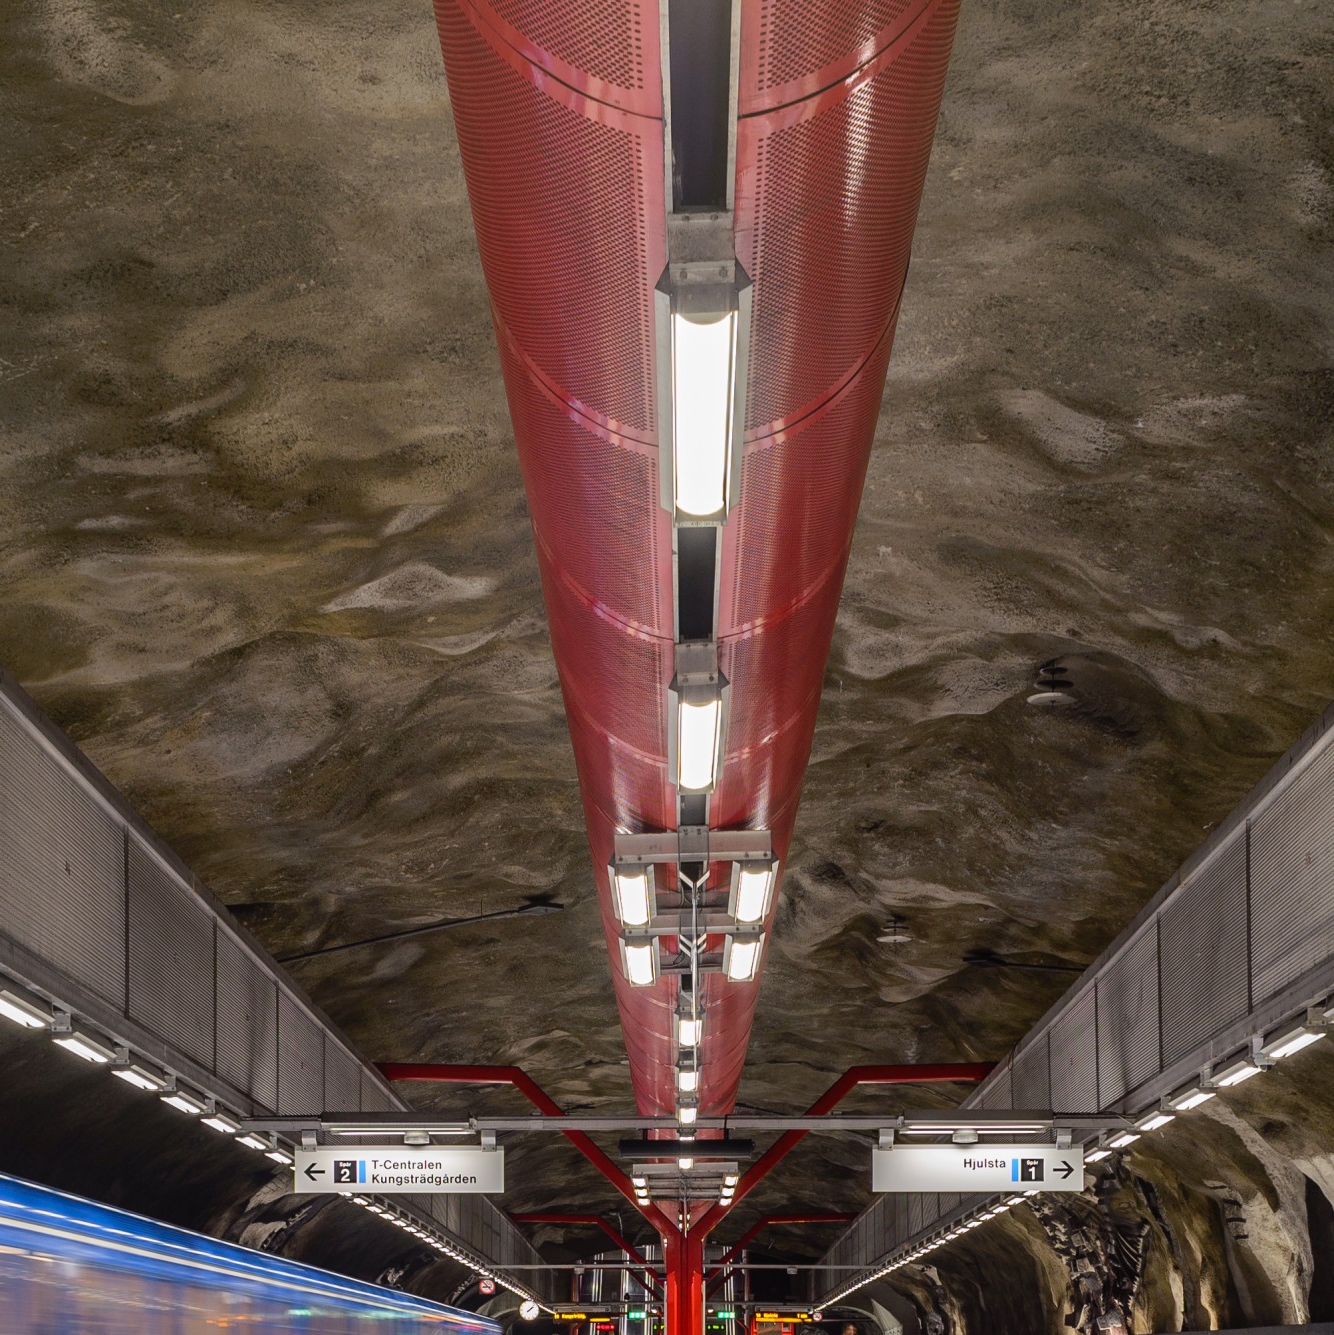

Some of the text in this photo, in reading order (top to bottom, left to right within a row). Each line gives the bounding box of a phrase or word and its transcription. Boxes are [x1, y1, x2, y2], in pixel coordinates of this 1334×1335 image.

[371, 1160, 442, 1170] T-Centralen
[963, 1158, 1006, 1170] Hjulsta
[340, 1168, 351, 1182] 2
[371, 1173, 477, 1185] Kungsträdgården
[1028, 1166, 1036, 1180] 1
